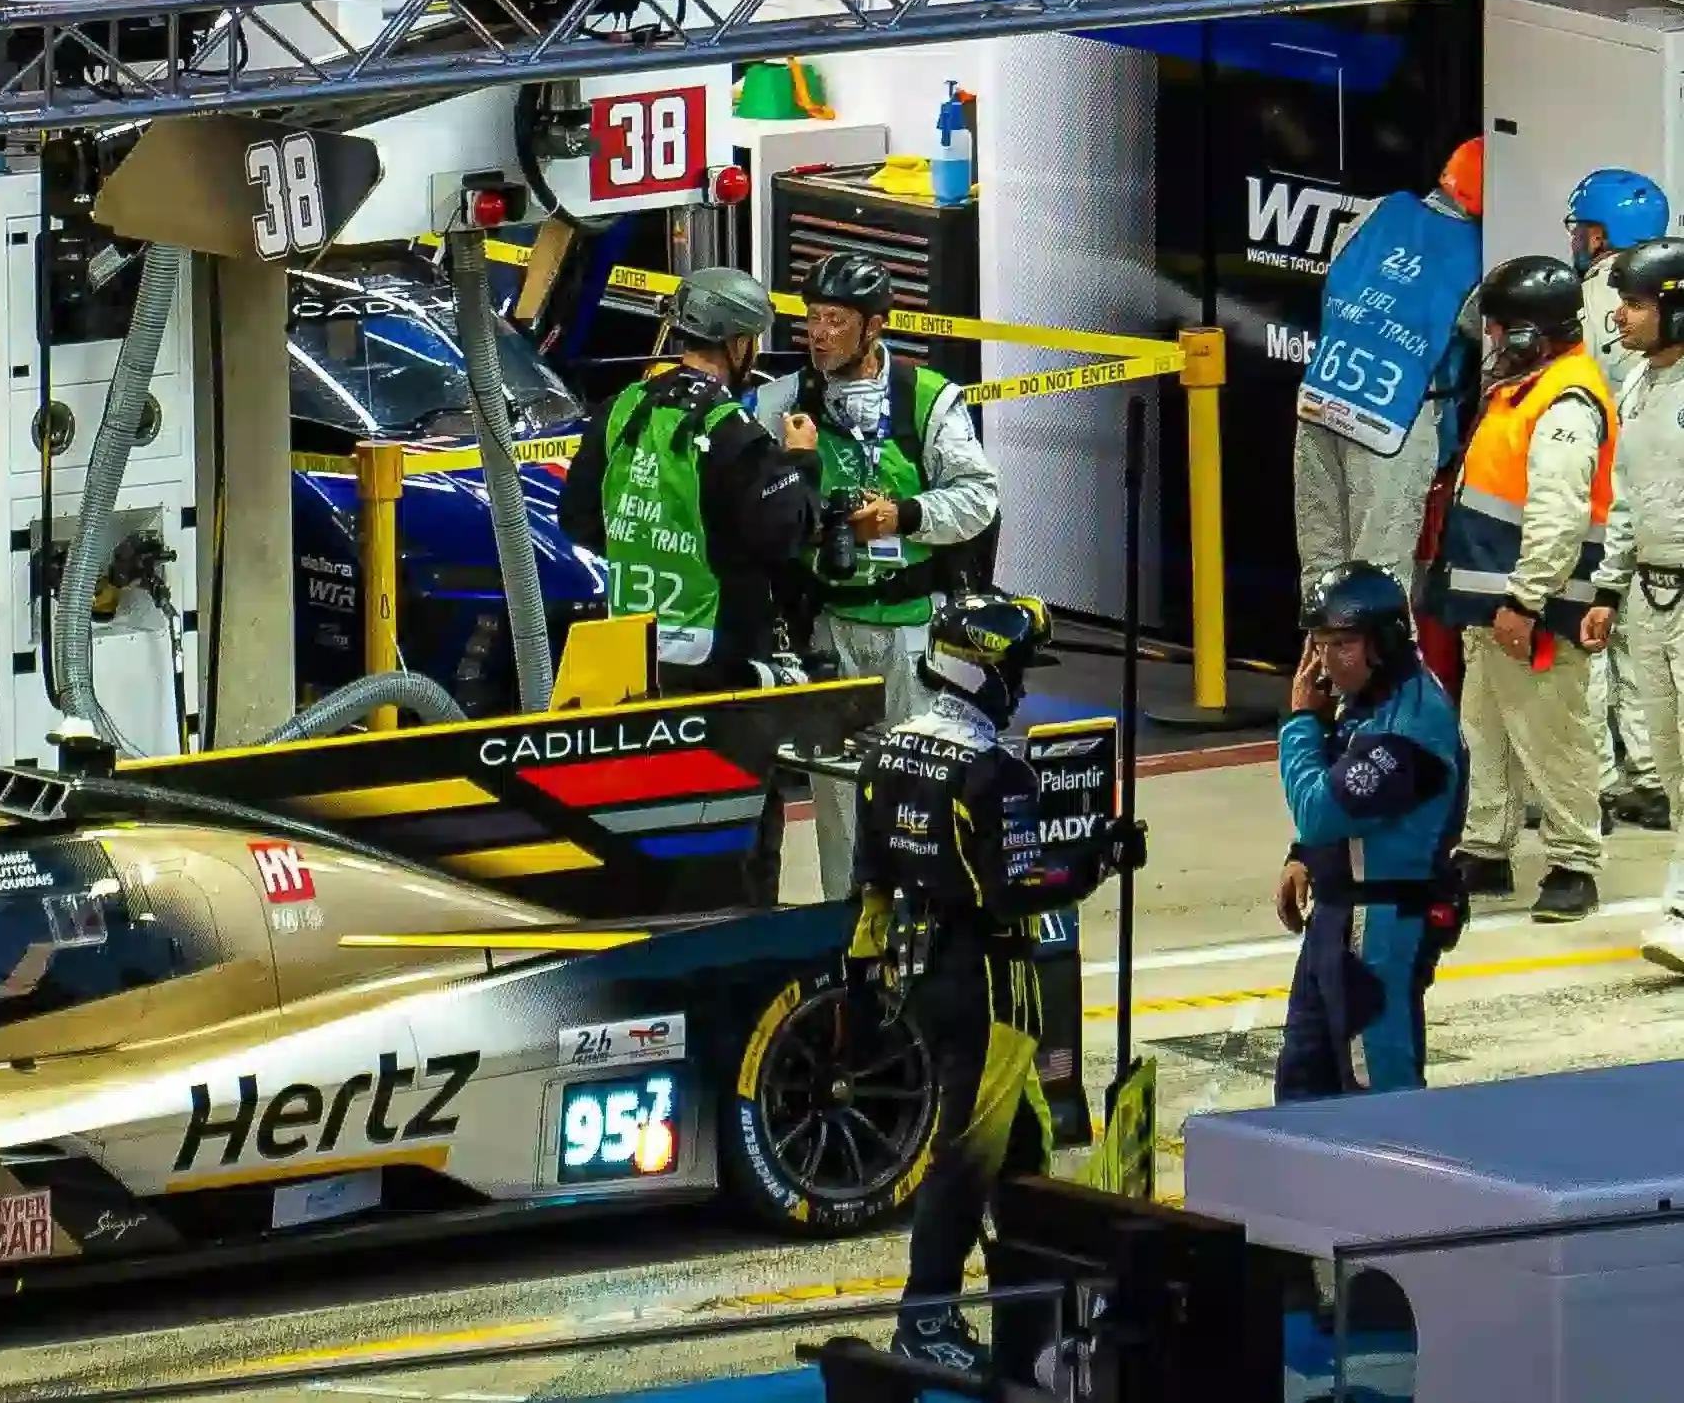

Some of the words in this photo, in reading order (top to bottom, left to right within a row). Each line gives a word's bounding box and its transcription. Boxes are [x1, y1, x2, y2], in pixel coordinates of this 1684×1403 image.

[609, 95, 689, 188] 38
[244, 131, 325, 262] 38
[1246, 247, 1289, 269] WAYNE
[615, 268, 647, 288] ENTER
[1359, 286, 1397, 314] FUEL
[894, 313, 917, 332] NOT
[921, 316, 954, 336] ENTER
[1377, 318, 1430, 358] TRACK
[964, 382, 1002, 403] TION
[1020, 377, 1040, 395] DO
[1046, 371, 1075, 390] NOT
[1081, 362, 1126, 385] ENTER
[1310, 334, 1404, 407] 1653
[514, 441, 567, 462] AUTION
[616, 493, 663, 523] MEDIA
[606, 515, 640, 544] LANE
[308, 577, 356, 607] WTR
[608, 560, 685, 618] 132
[480, 716, 709, 767] CADILLAC
[878, 753, 949, 781] RACING
[1041, 765, 1105, 793] Palantir
[172, 1049, 481, 1173] Hertz
